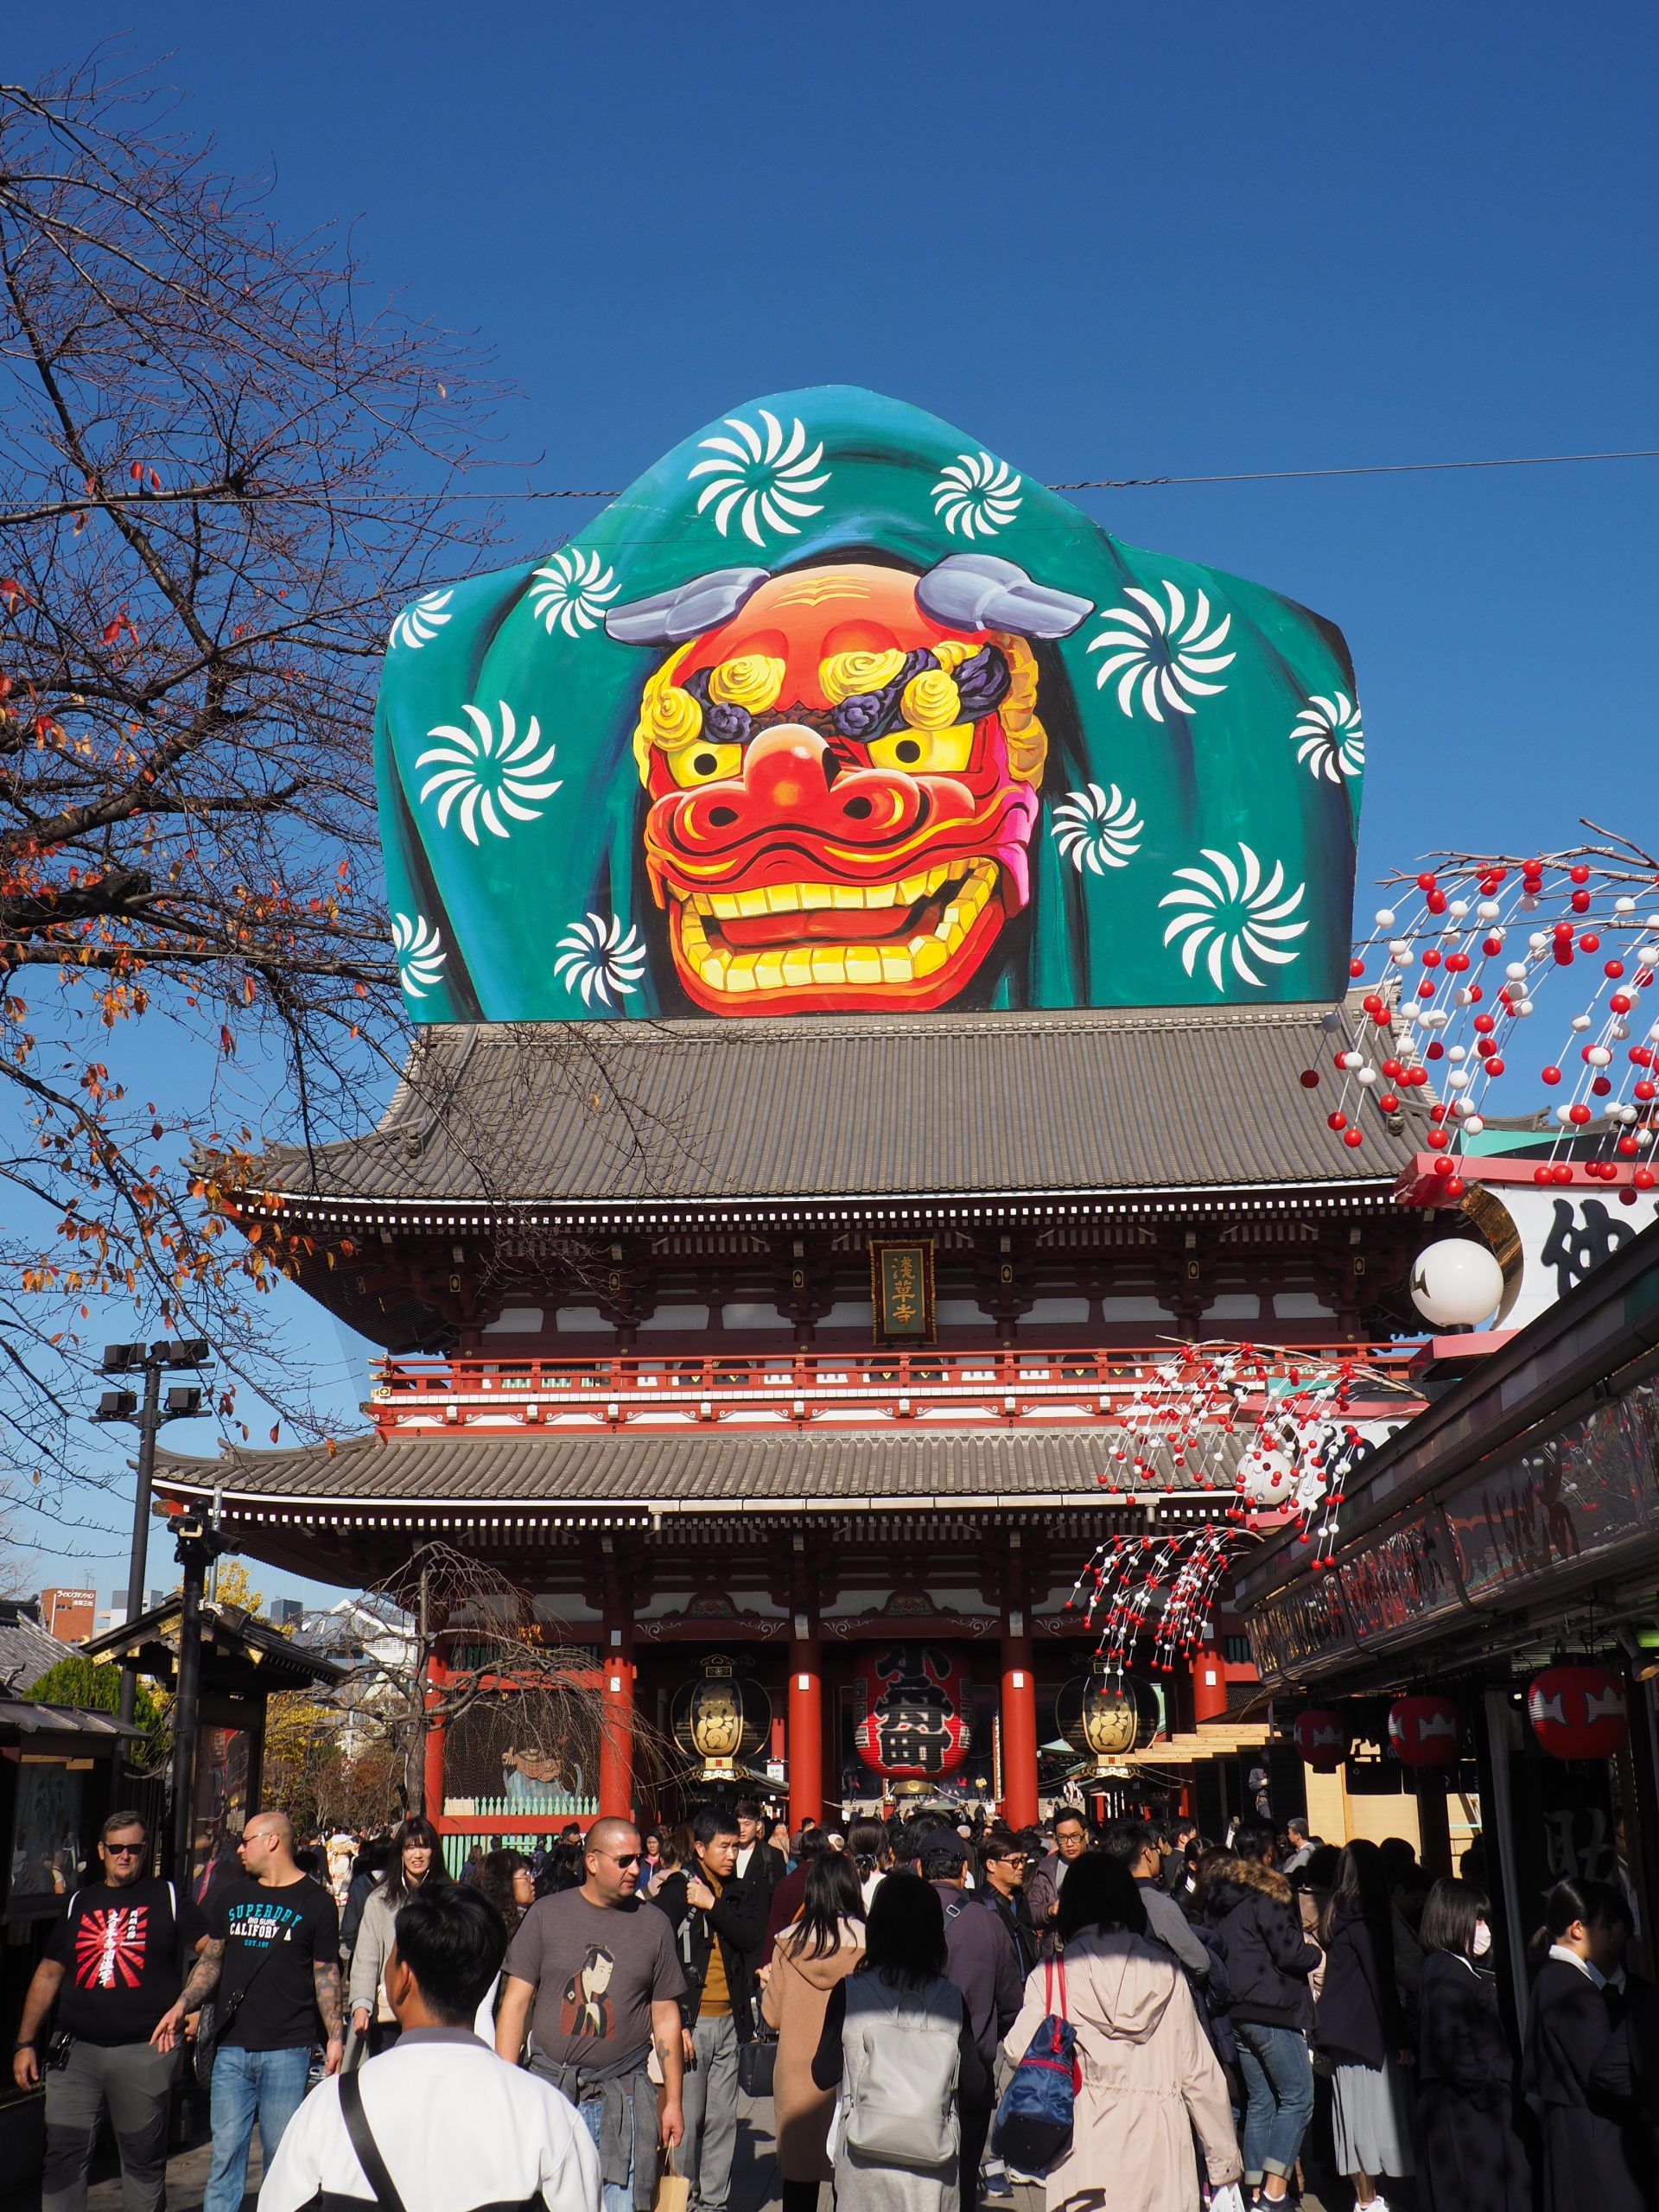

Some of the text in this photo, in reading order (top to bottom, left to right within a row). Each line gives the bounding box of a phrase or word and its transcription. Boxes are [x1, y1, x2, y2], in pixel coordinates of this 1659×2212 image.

[1541, 1198, 1659, 1298] 仲
[228, 1904, 302, 1928] SUPERDRY
[230, 1923, 291, 1942] CALIFORA
